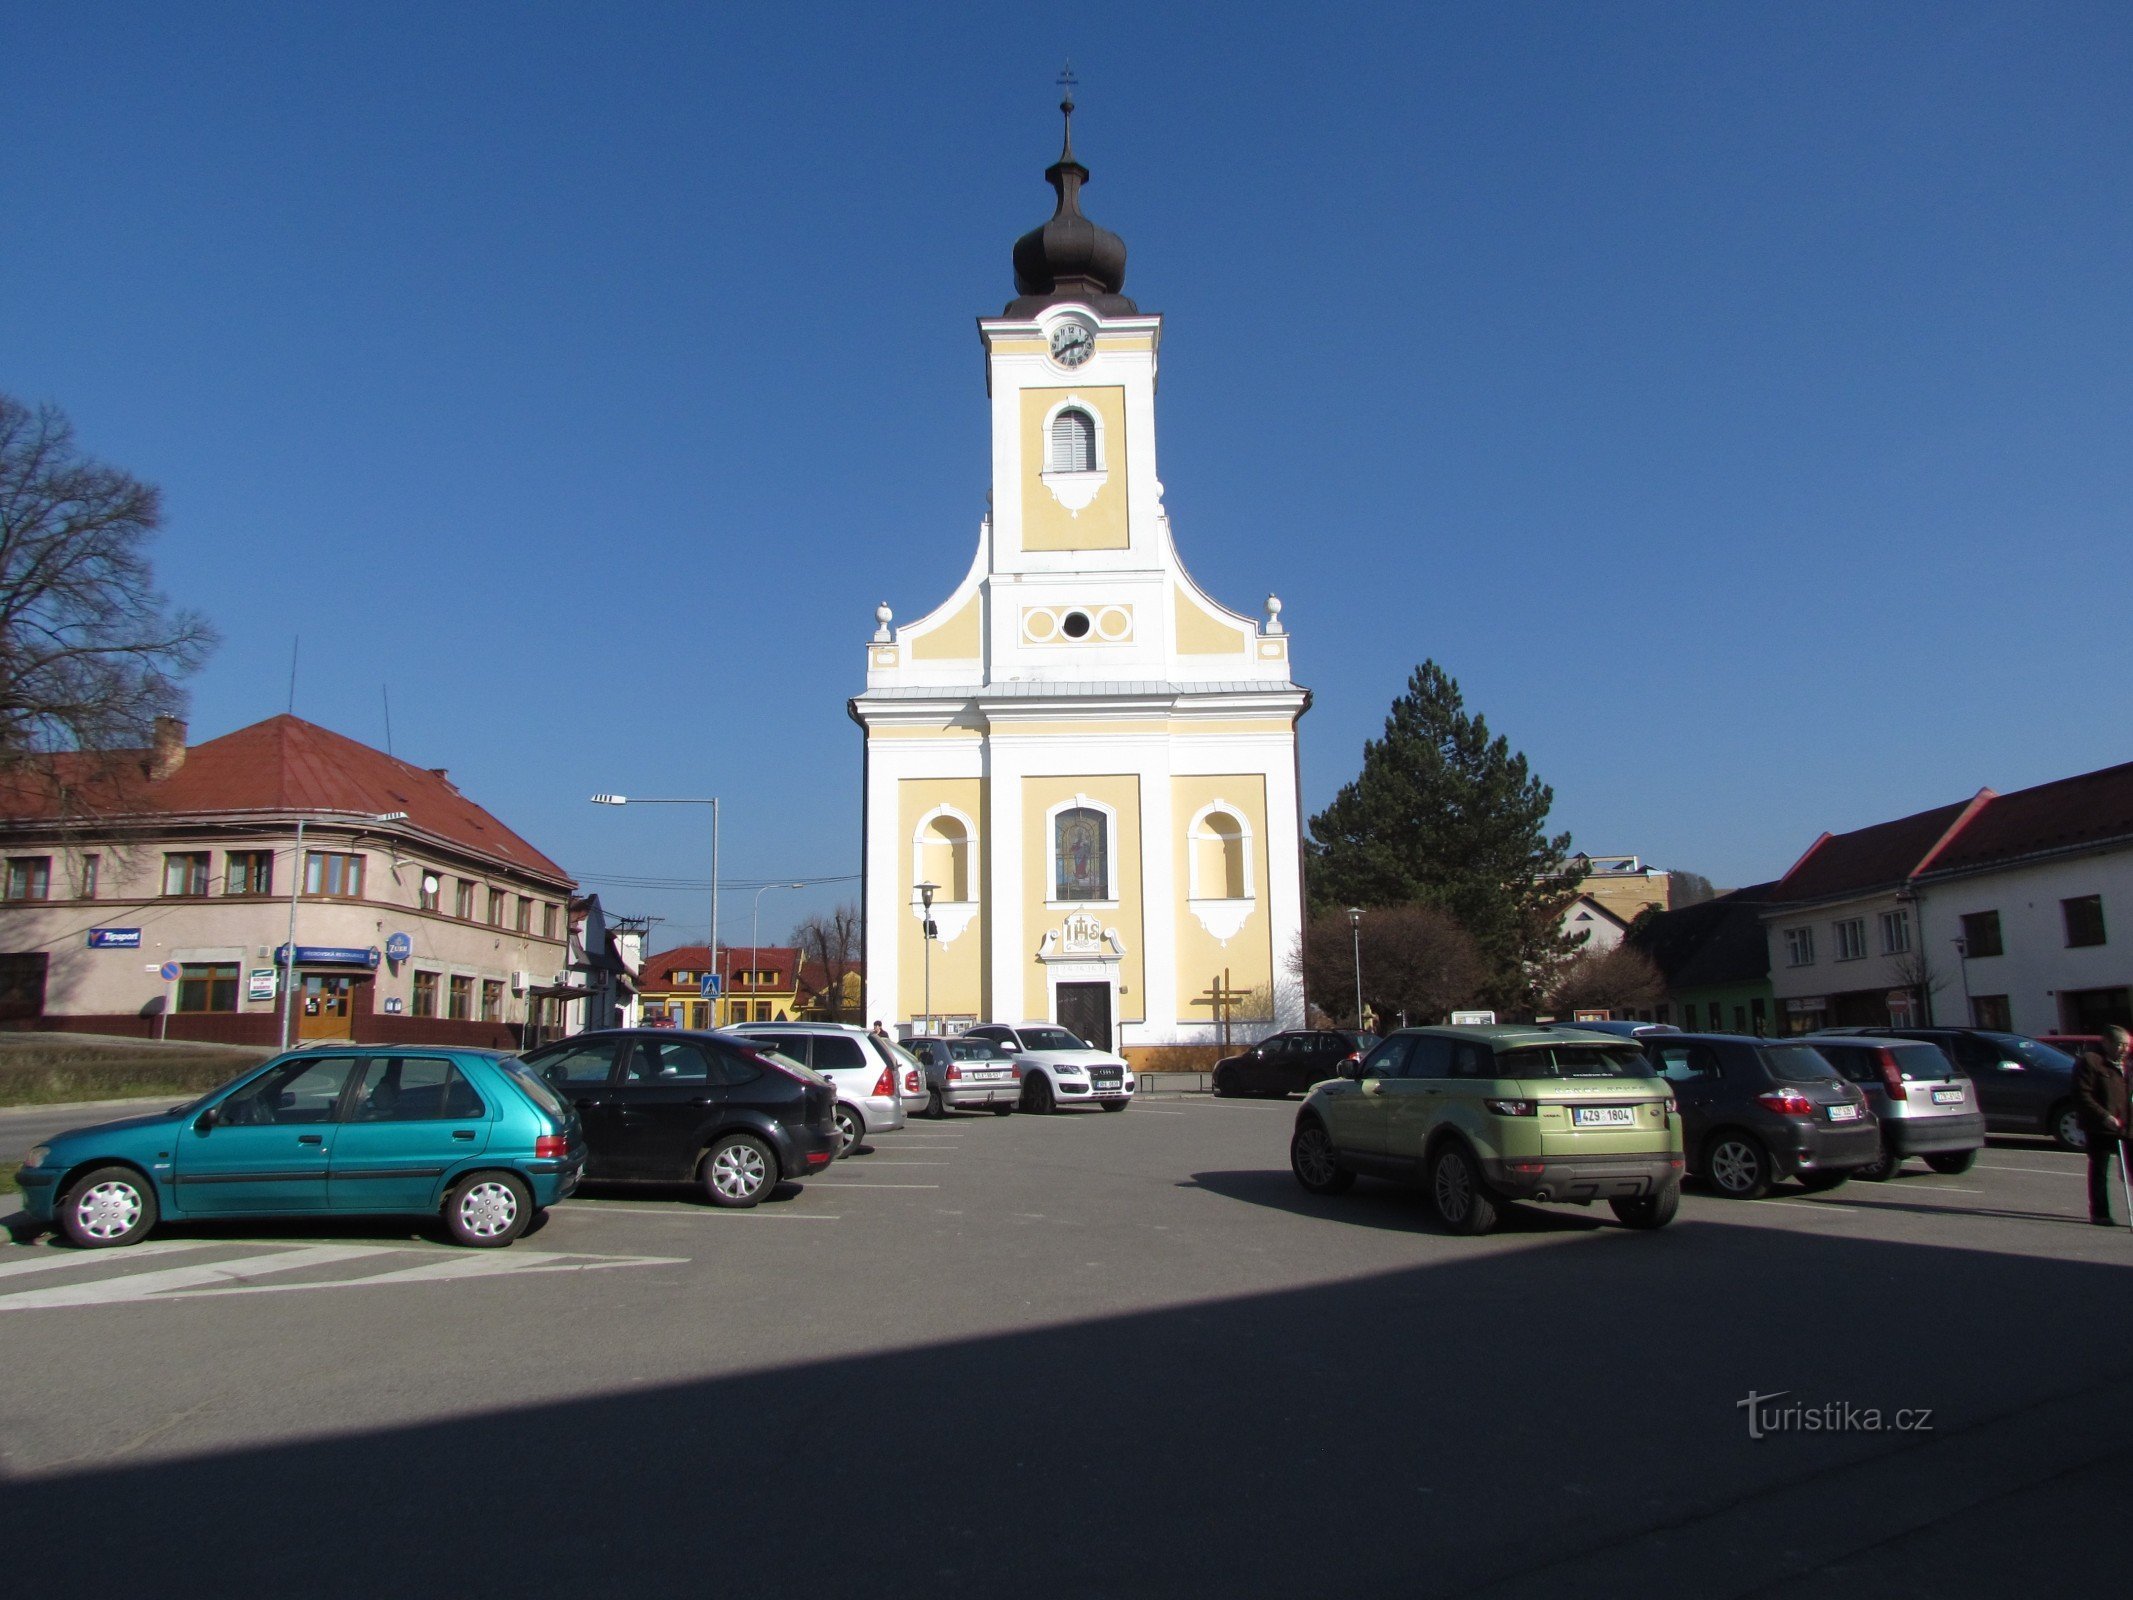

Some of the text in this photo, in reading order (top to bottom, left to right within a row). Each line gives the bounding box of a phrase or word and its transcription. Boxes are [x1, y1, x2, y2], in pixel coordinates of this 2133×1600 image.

[1067, 918, 1099, 941] IHS
[105, 932, 139, 941] Tipsport
[1582, 1109, 1629, 1121] 4Z9 1804
